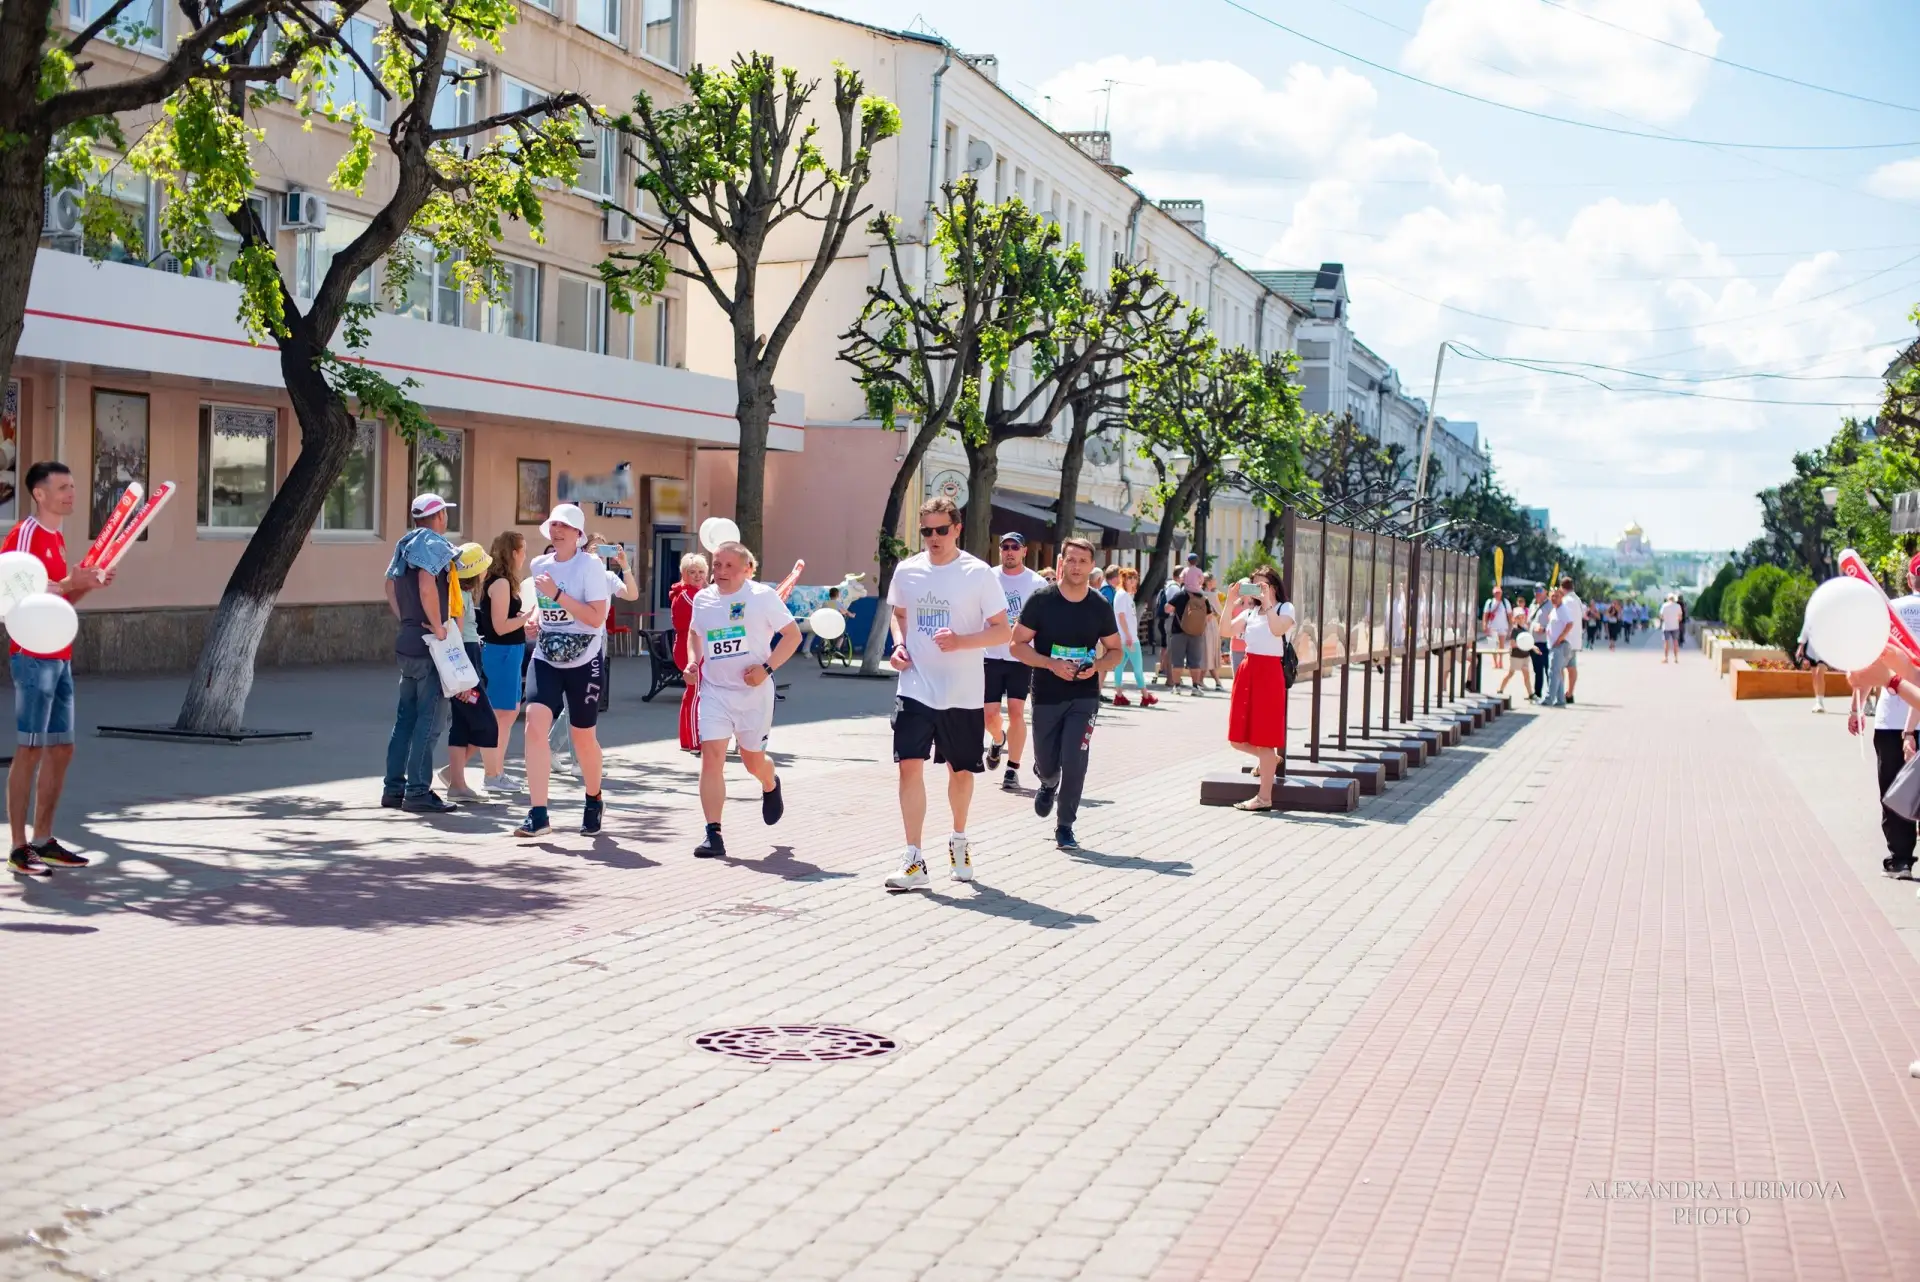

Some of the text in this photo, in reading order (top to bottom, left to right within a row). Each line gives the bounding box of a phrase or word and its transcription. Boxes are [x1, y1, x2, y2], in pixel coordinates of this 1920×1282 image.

[542, 609, 569, 622] 552
[713, 639, 742, 655] 857
[584, 682, 601, 705] 27
